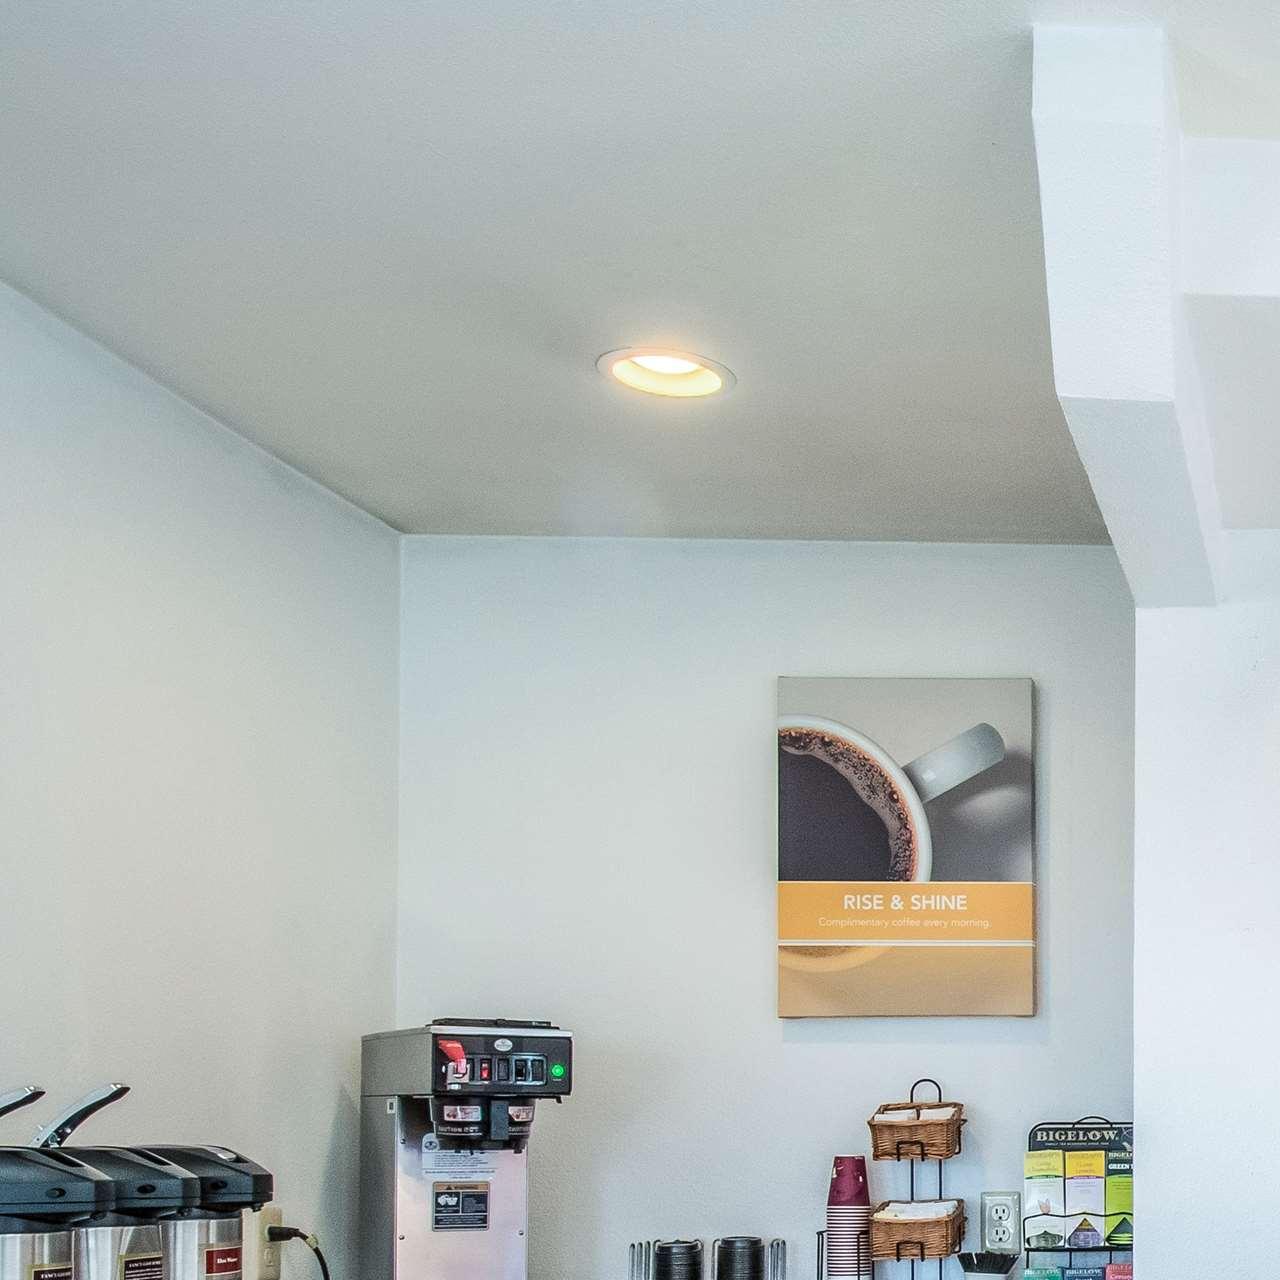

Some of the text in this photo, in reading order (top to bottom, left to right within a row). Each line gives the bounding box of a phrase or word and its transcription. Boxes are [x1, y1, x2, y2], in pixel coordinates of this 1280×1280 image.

[843, 894, 968, 911] RISE & SHINE
[818, 917, 889, 929] Complimentary
[892, 917, 921, 927] coffee
[923, 919, 949, 929] every
[1036, 1130, 1117, 1142] BIGELOW
